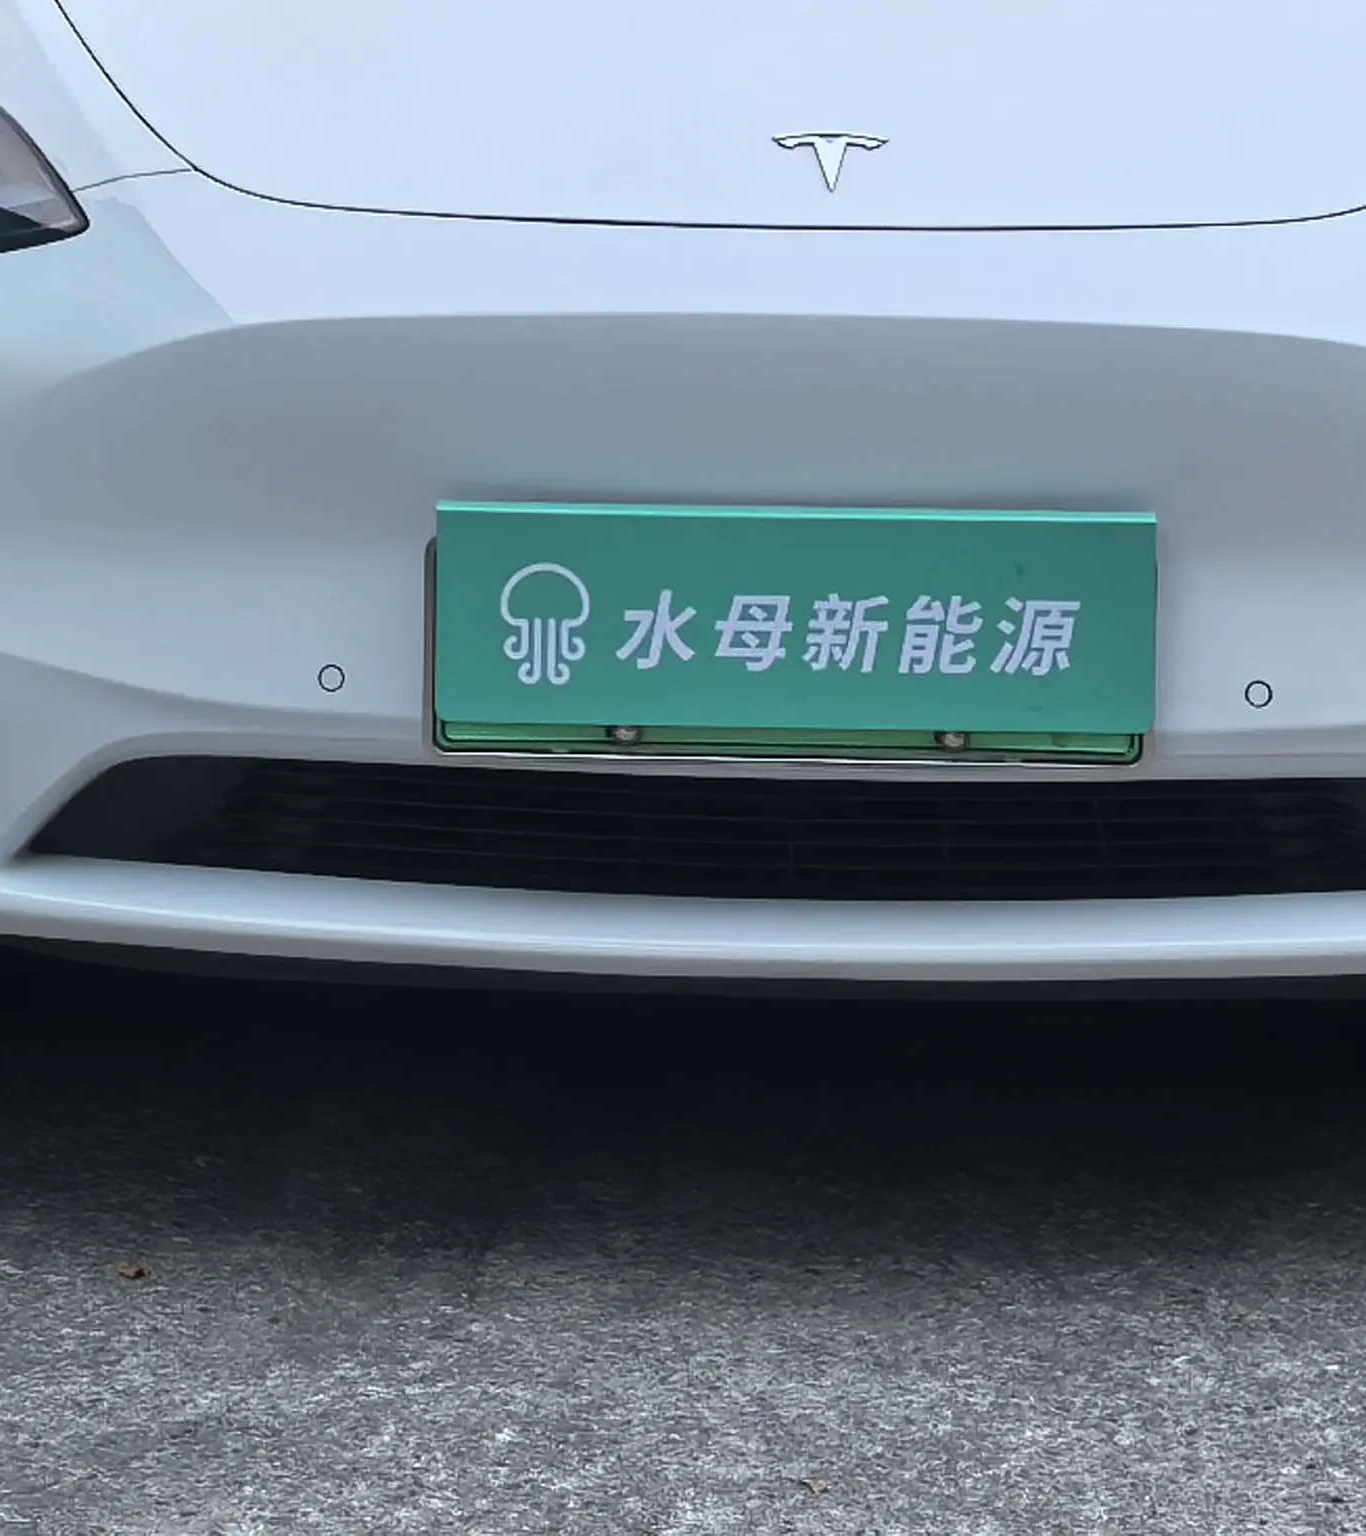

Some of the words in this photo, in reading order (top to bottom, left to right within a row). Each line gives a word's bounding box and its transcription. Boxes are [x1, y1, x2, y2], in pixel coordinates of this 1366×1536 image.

[615, 589, 1081, 677] 水母新能源
